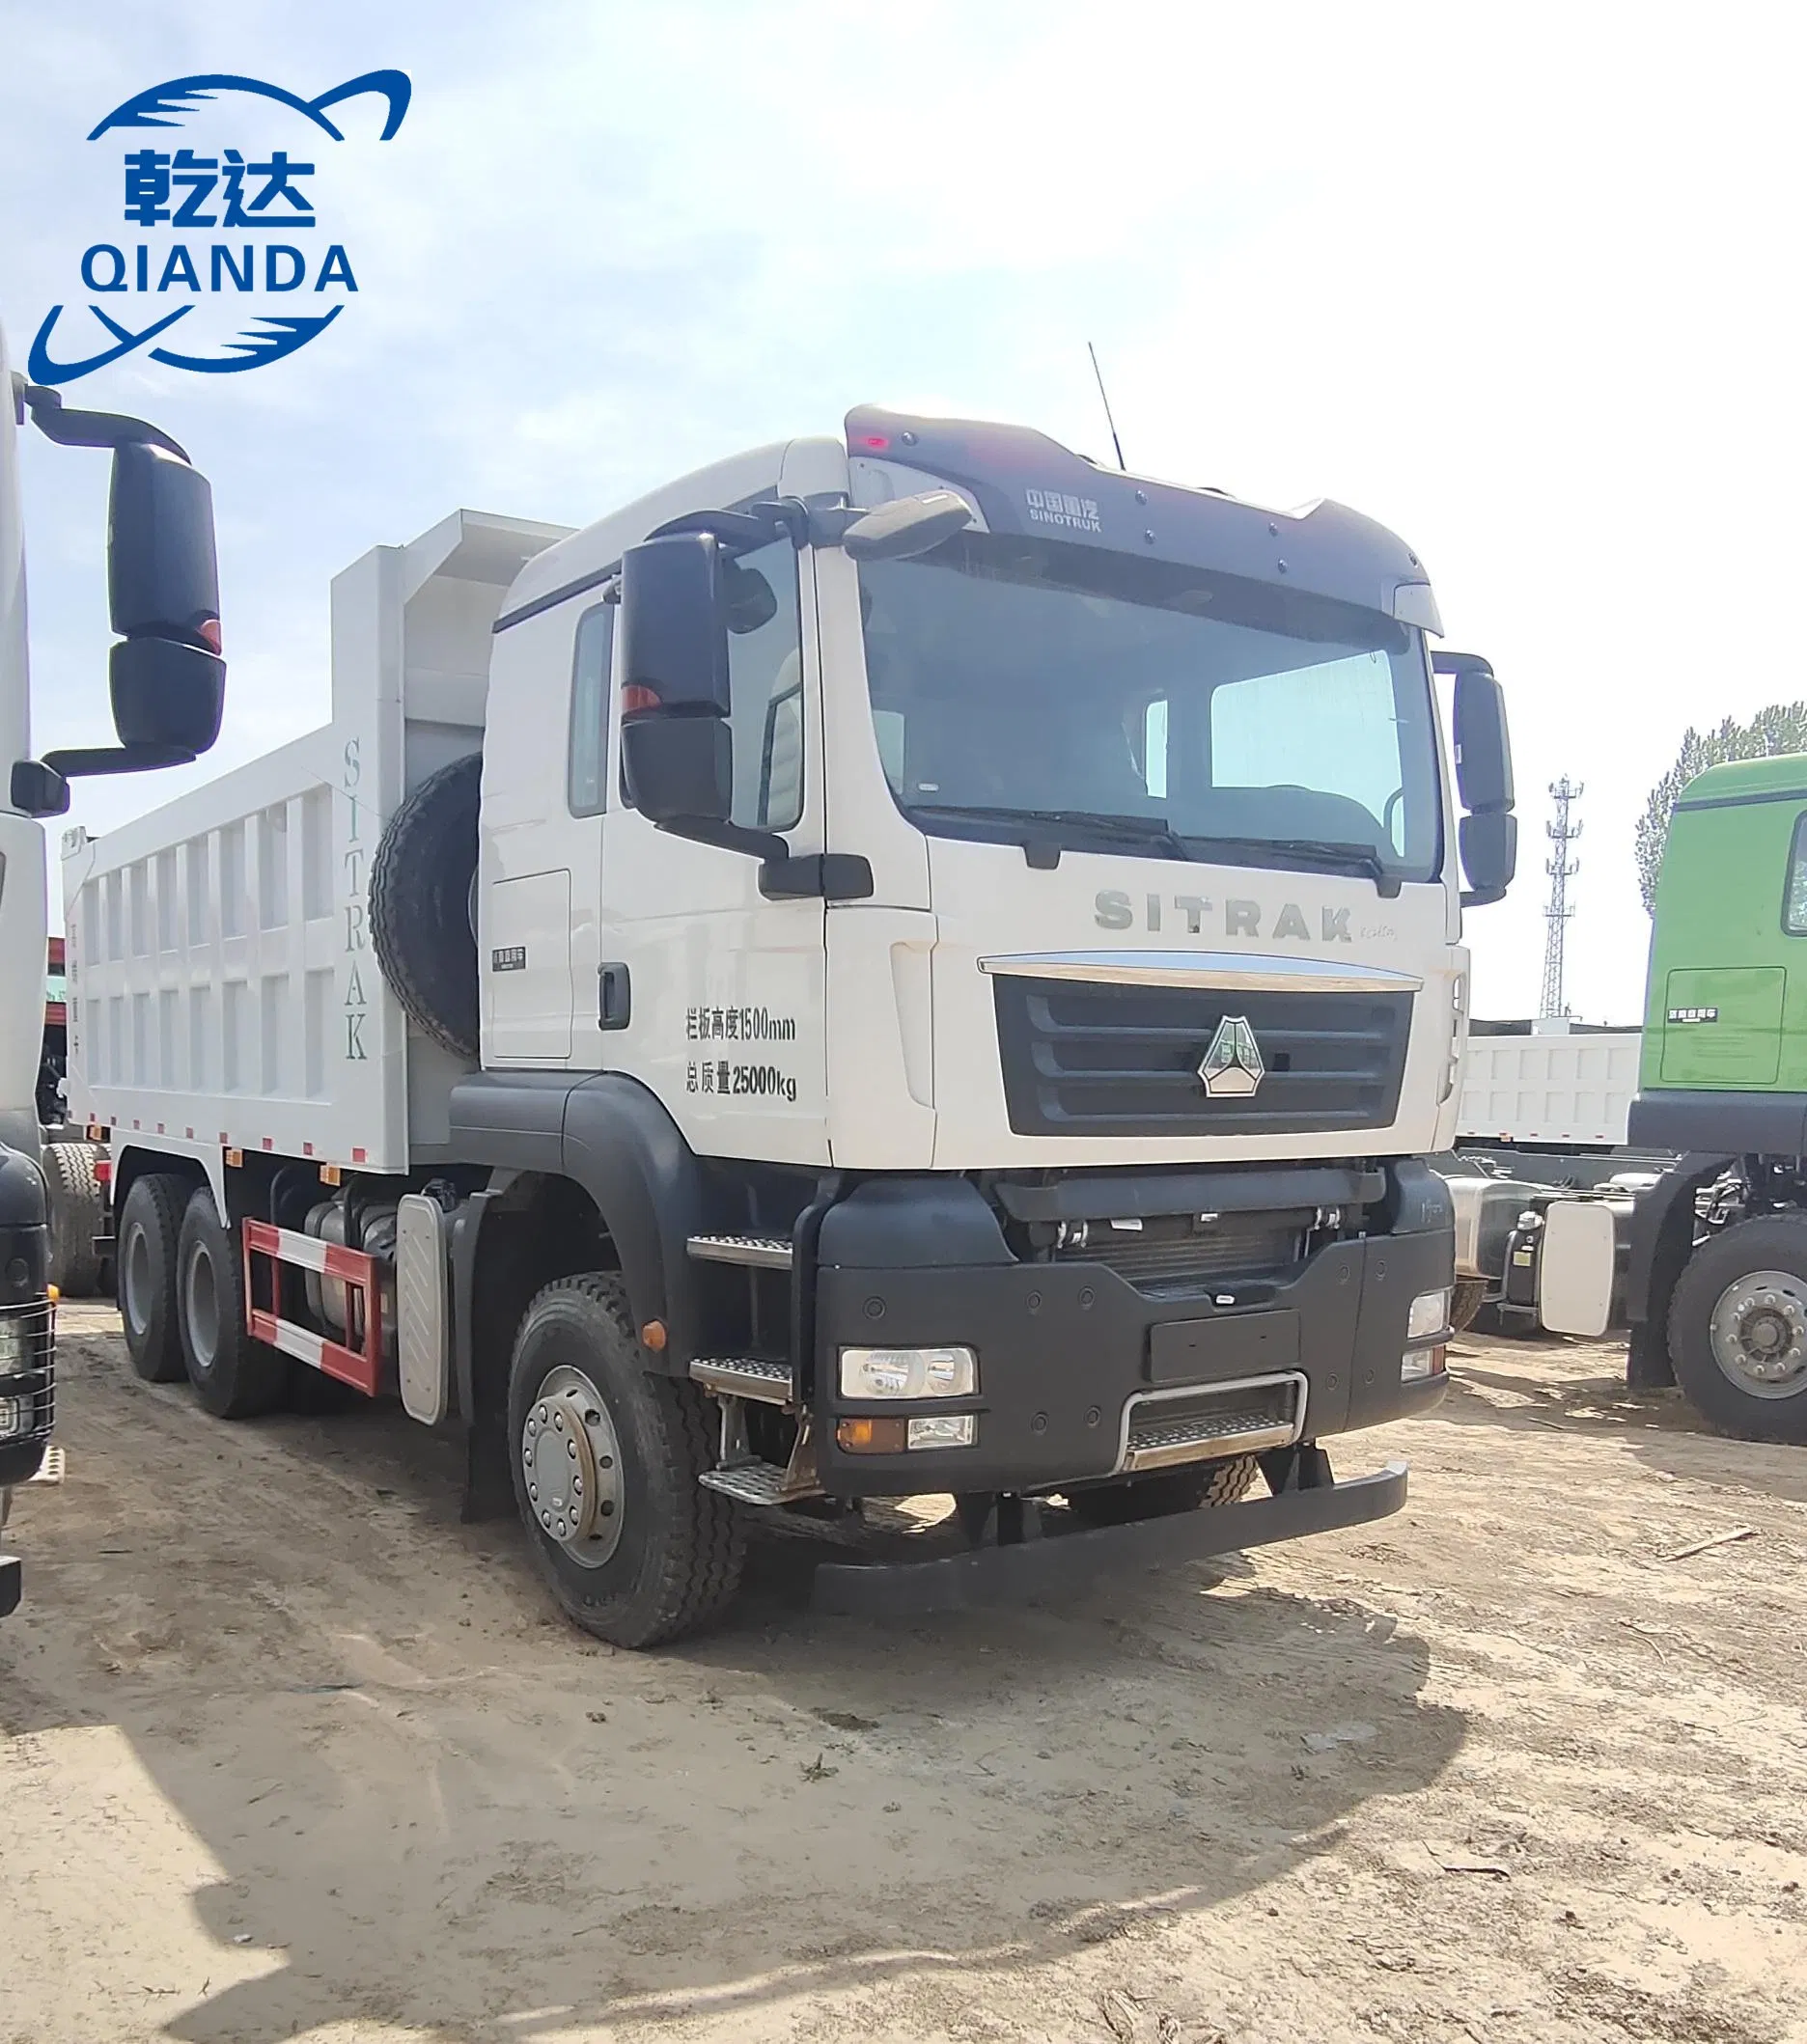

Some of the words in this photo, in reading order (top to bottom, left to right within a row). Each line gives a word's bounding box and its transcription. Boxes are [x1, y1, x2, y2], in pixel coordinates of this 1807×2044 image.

[1028, 508, 1102, 534] SINOTRUK
[344, 736, 367, 1061] SITRAK
[1094, 889, 1353, 943] SITRAK
[686, 1006, 796, 1041] 栏板高度1500mm
[686, 1061, 797, 1102] 总质量25000kg
